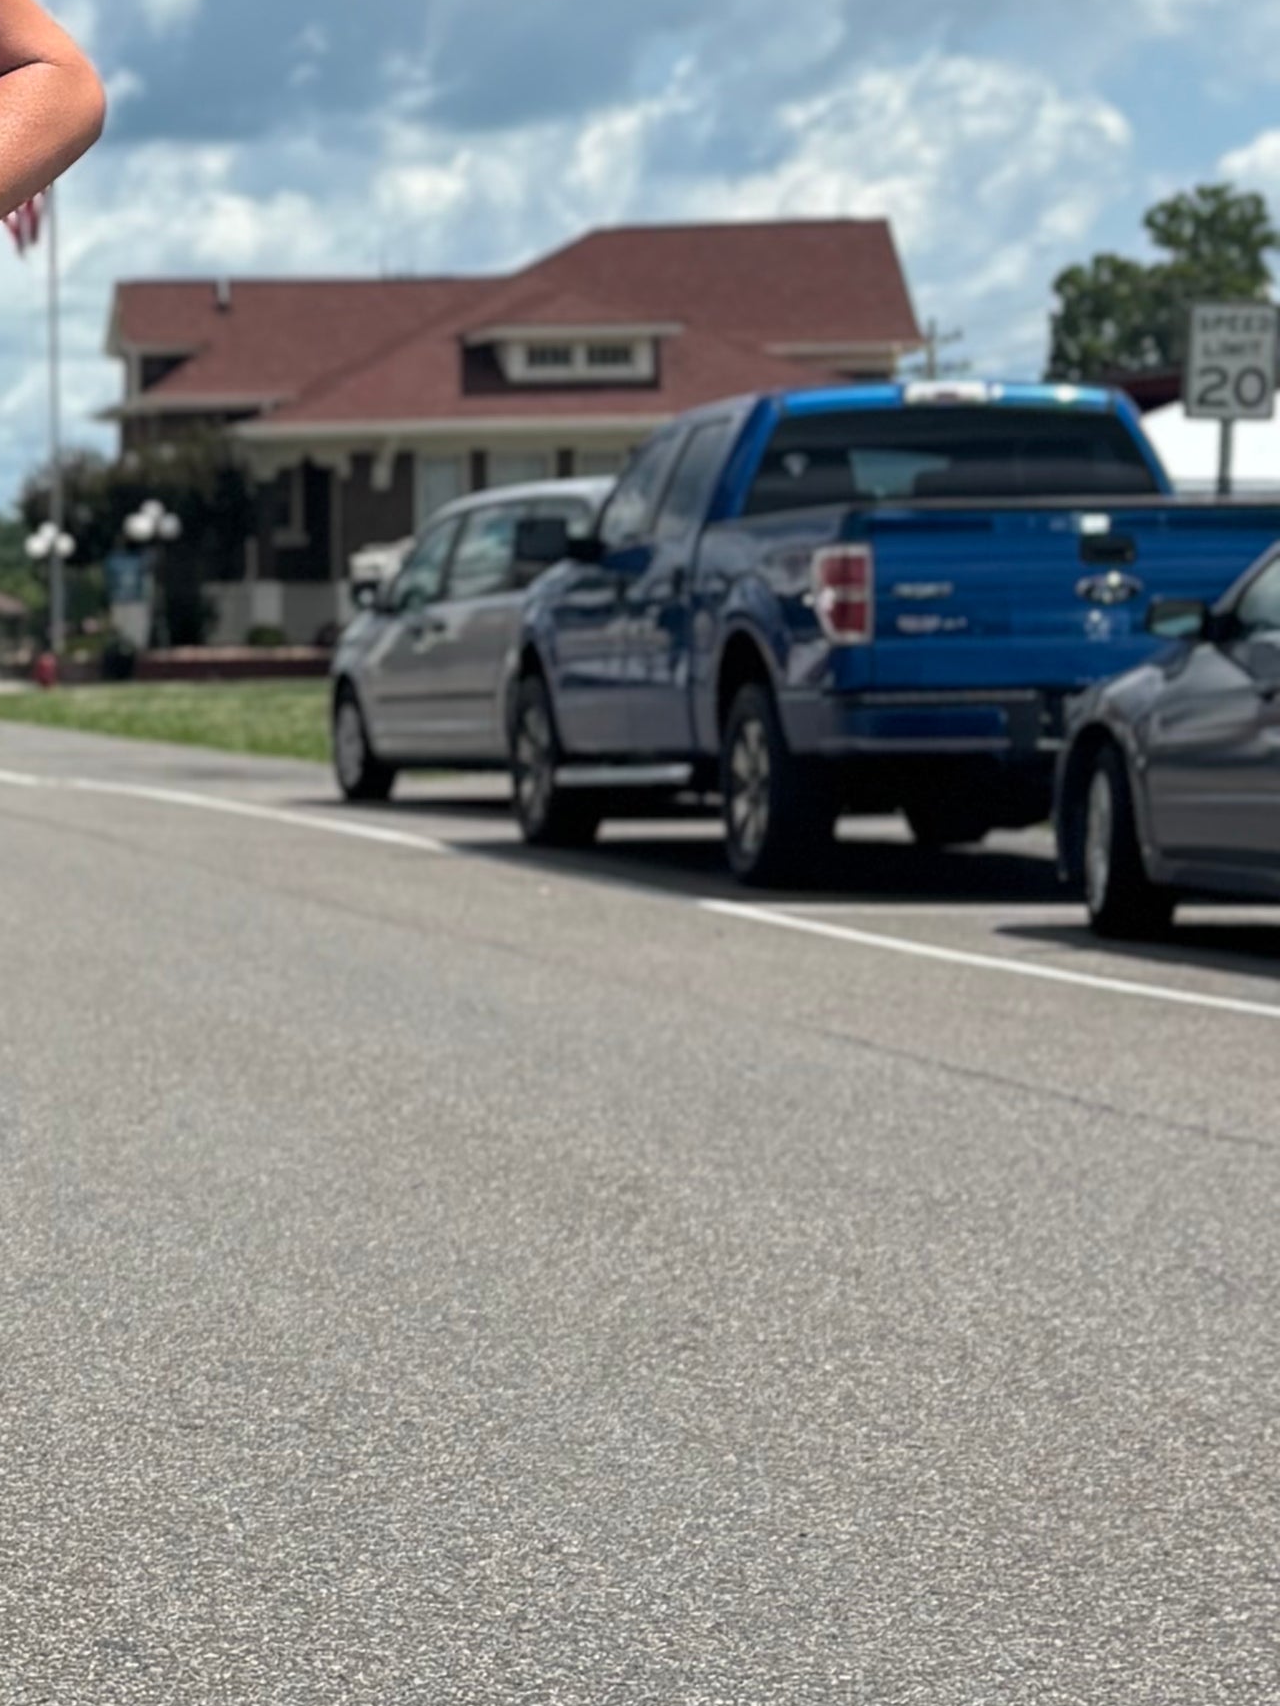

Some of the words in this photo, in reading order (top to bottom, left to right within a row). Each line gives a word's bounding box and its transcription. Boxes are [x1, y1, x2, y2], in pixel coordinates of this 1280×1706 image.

[1200, 314, 1272, 333] SPEED
[1201, 339, 1262, 356] LIMIT
[1197, 366, 1267, 409] 20
